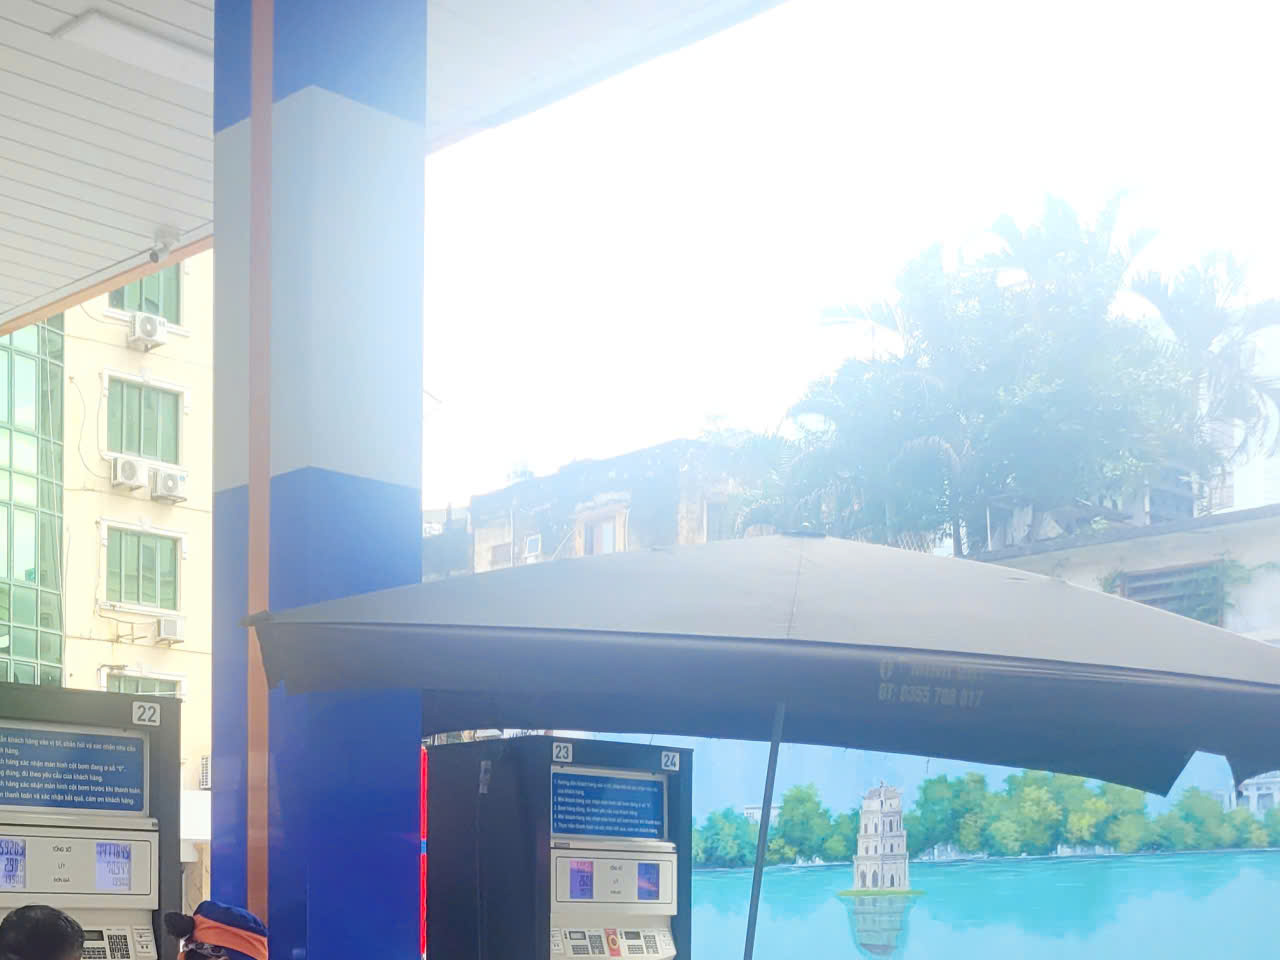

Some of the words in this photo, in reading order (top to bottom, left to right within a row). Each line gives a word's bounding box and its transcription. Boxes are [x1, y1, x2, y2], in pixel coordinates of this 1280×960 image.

[136, 704, 157, 723] 22
[555, 744, 570, 760] 23
[663, 753, 677, 768] 24
